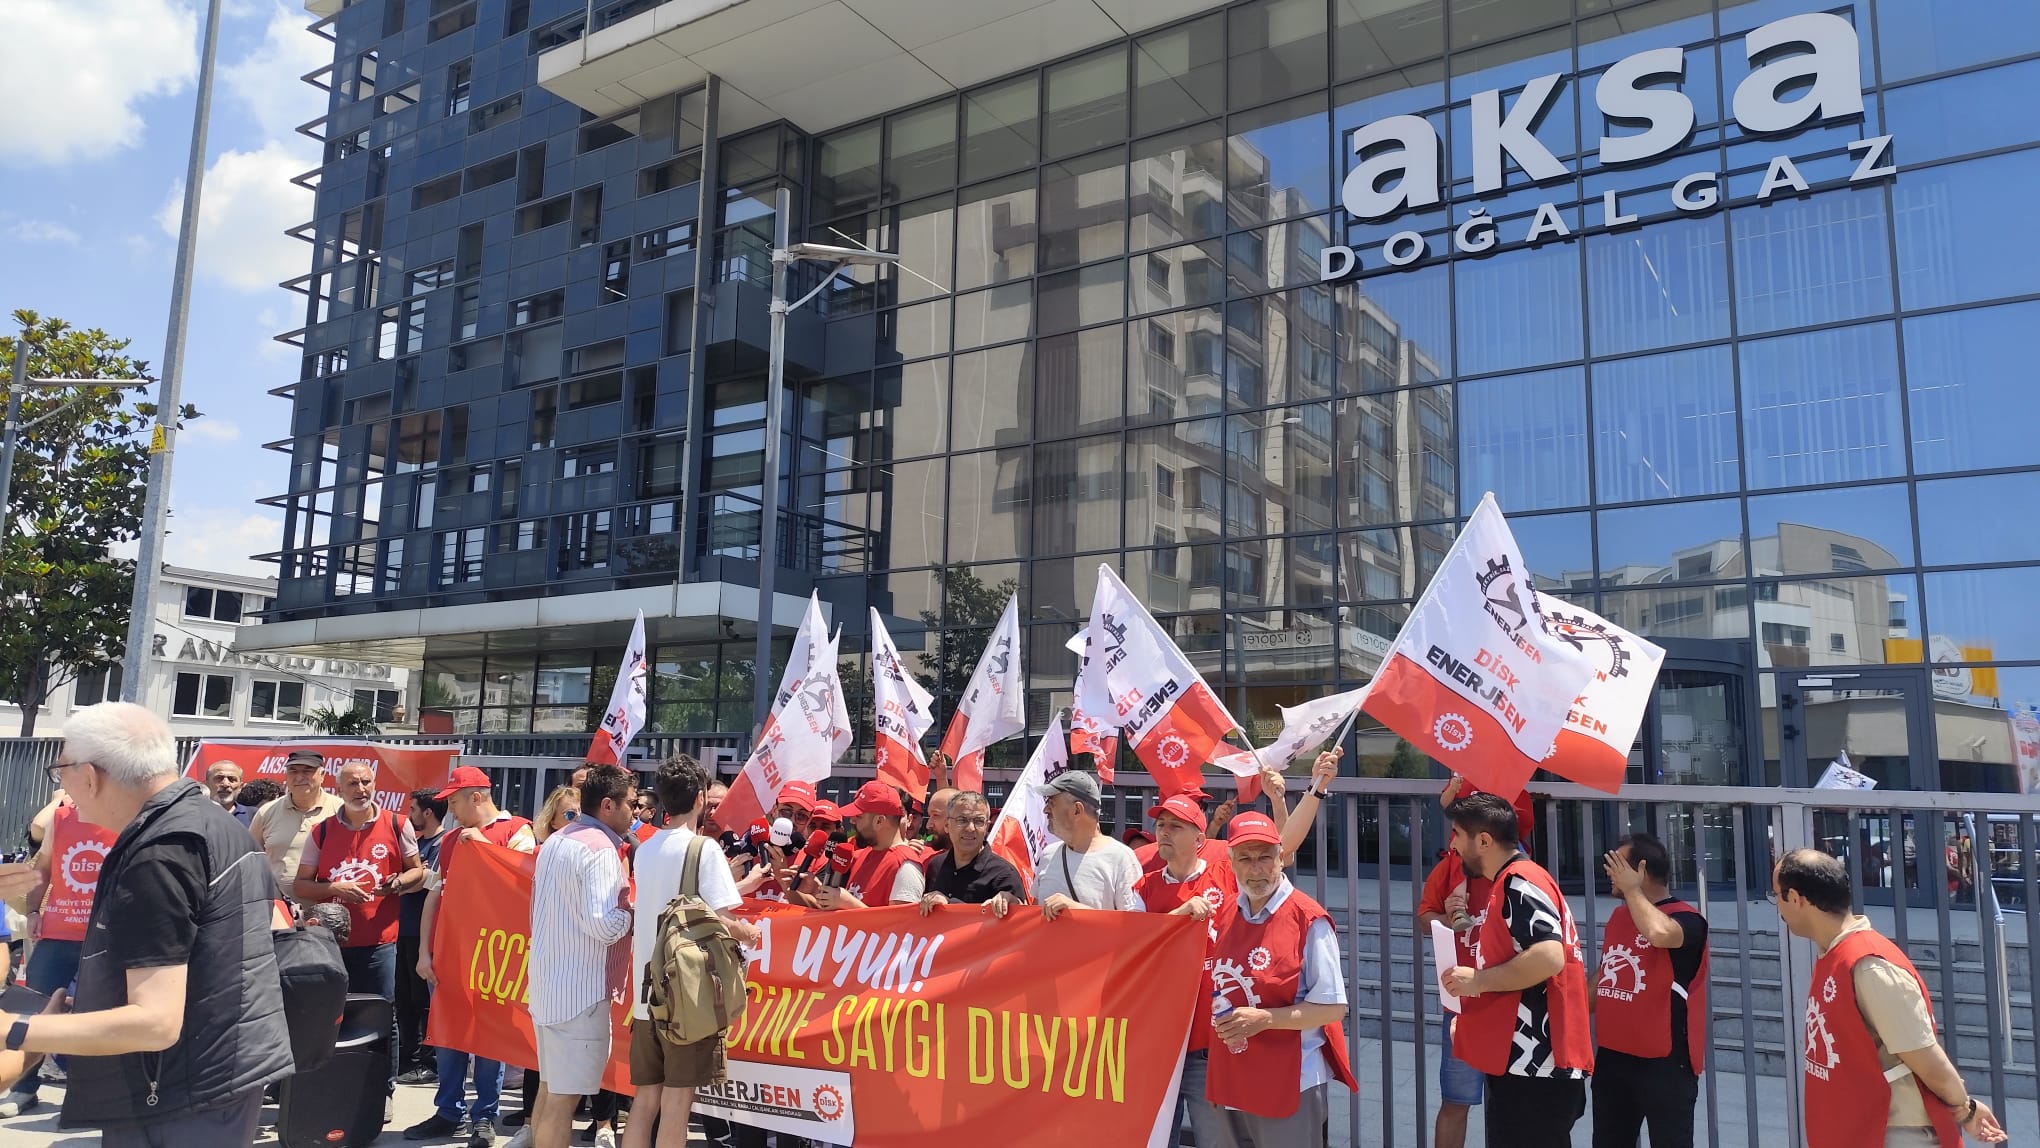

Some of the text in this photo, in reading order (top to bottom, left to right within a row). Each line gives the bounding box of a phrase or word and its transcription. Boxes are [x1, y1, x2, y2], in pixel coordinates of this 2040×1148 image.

[1342, 12, 1865, 219] aksa
[1320, 135, 1897, 282] DOĞALGAZ
[1473, 647, 1521, 694] DİSK
[1442, 722, 1465, 741] DİSK
[793, 924, 945, 994] UYUN!
[822, 994, 946, 1081] SAYGI
[968, 1006, 1128, 1104] DUYUN
[819, 1096, 837, 1107] DİSK
